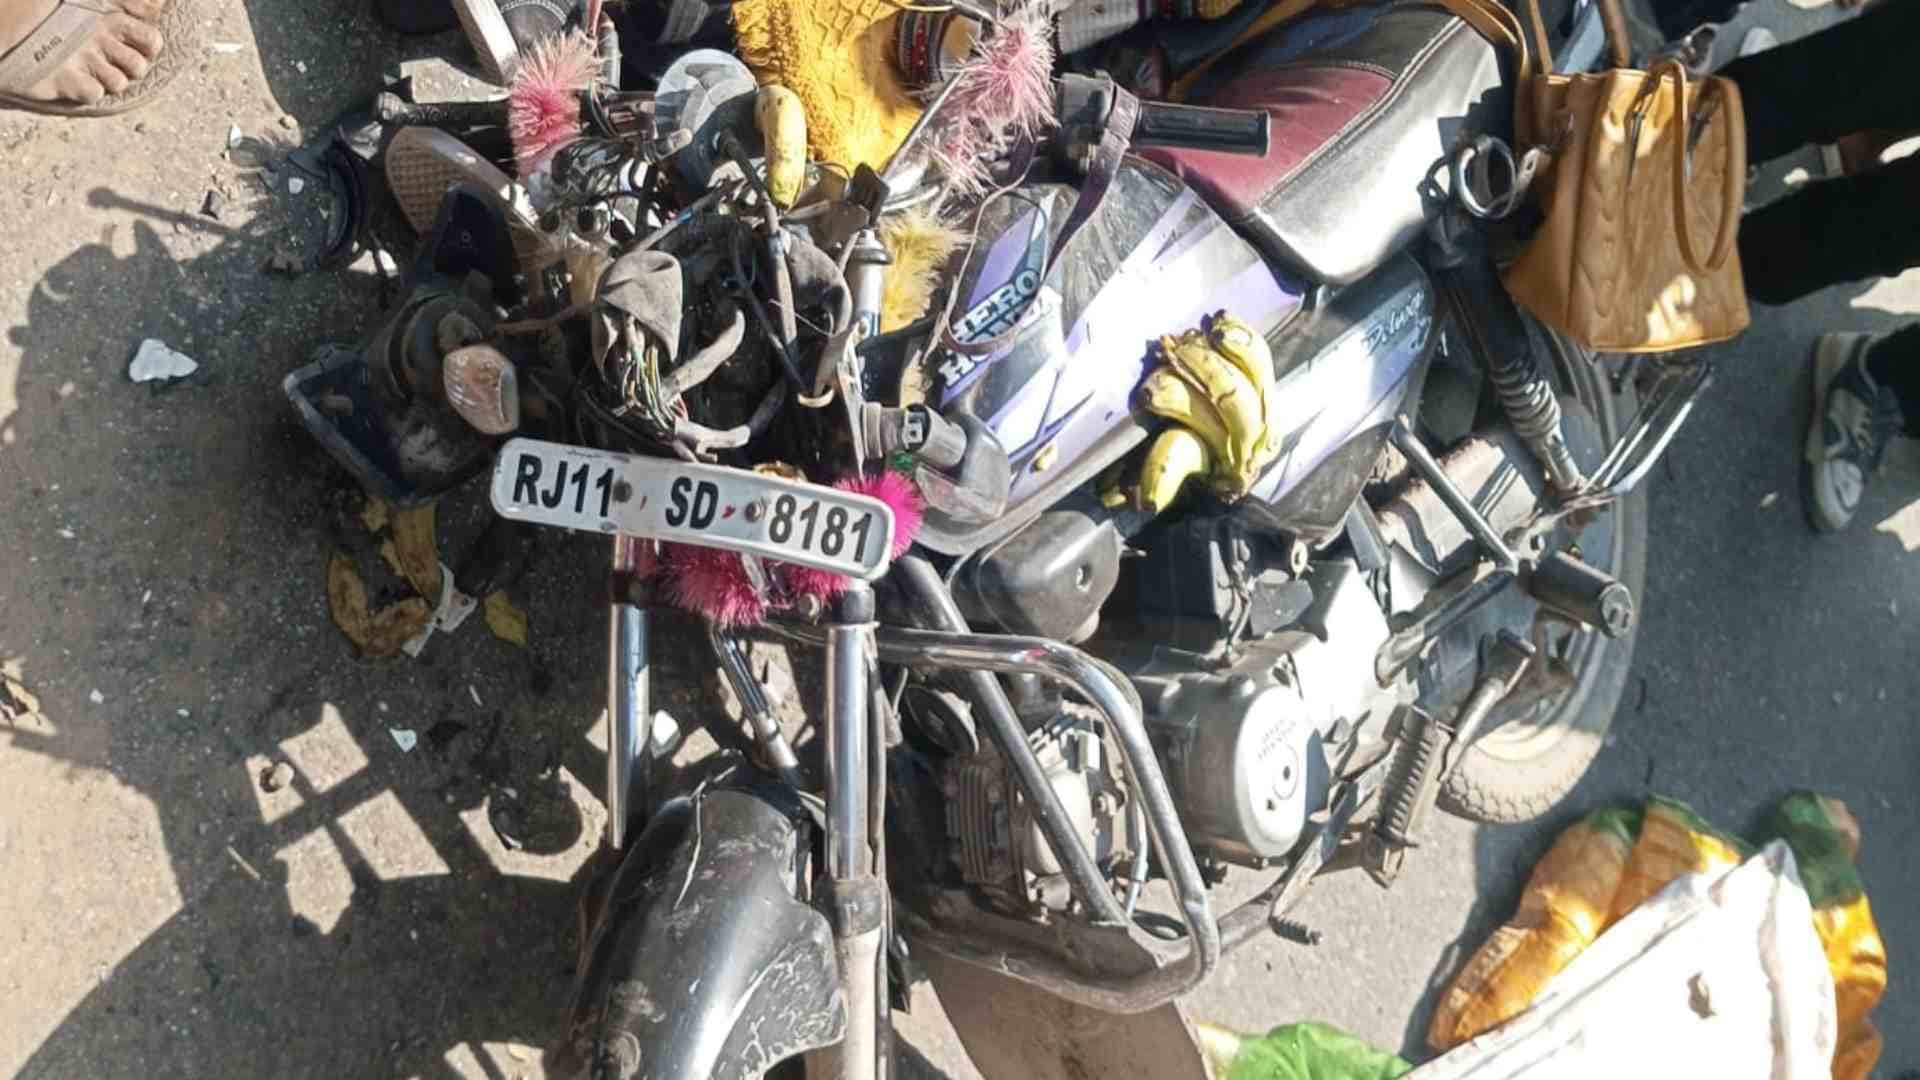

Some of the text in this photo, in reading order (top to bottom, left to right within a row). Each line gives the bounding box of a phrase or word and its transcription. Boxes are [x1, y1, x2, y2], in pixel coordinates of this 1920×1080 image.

[953, 269, 1038, 342] HERO
[512, 454, 872, 563] RJ11 SD 8181
